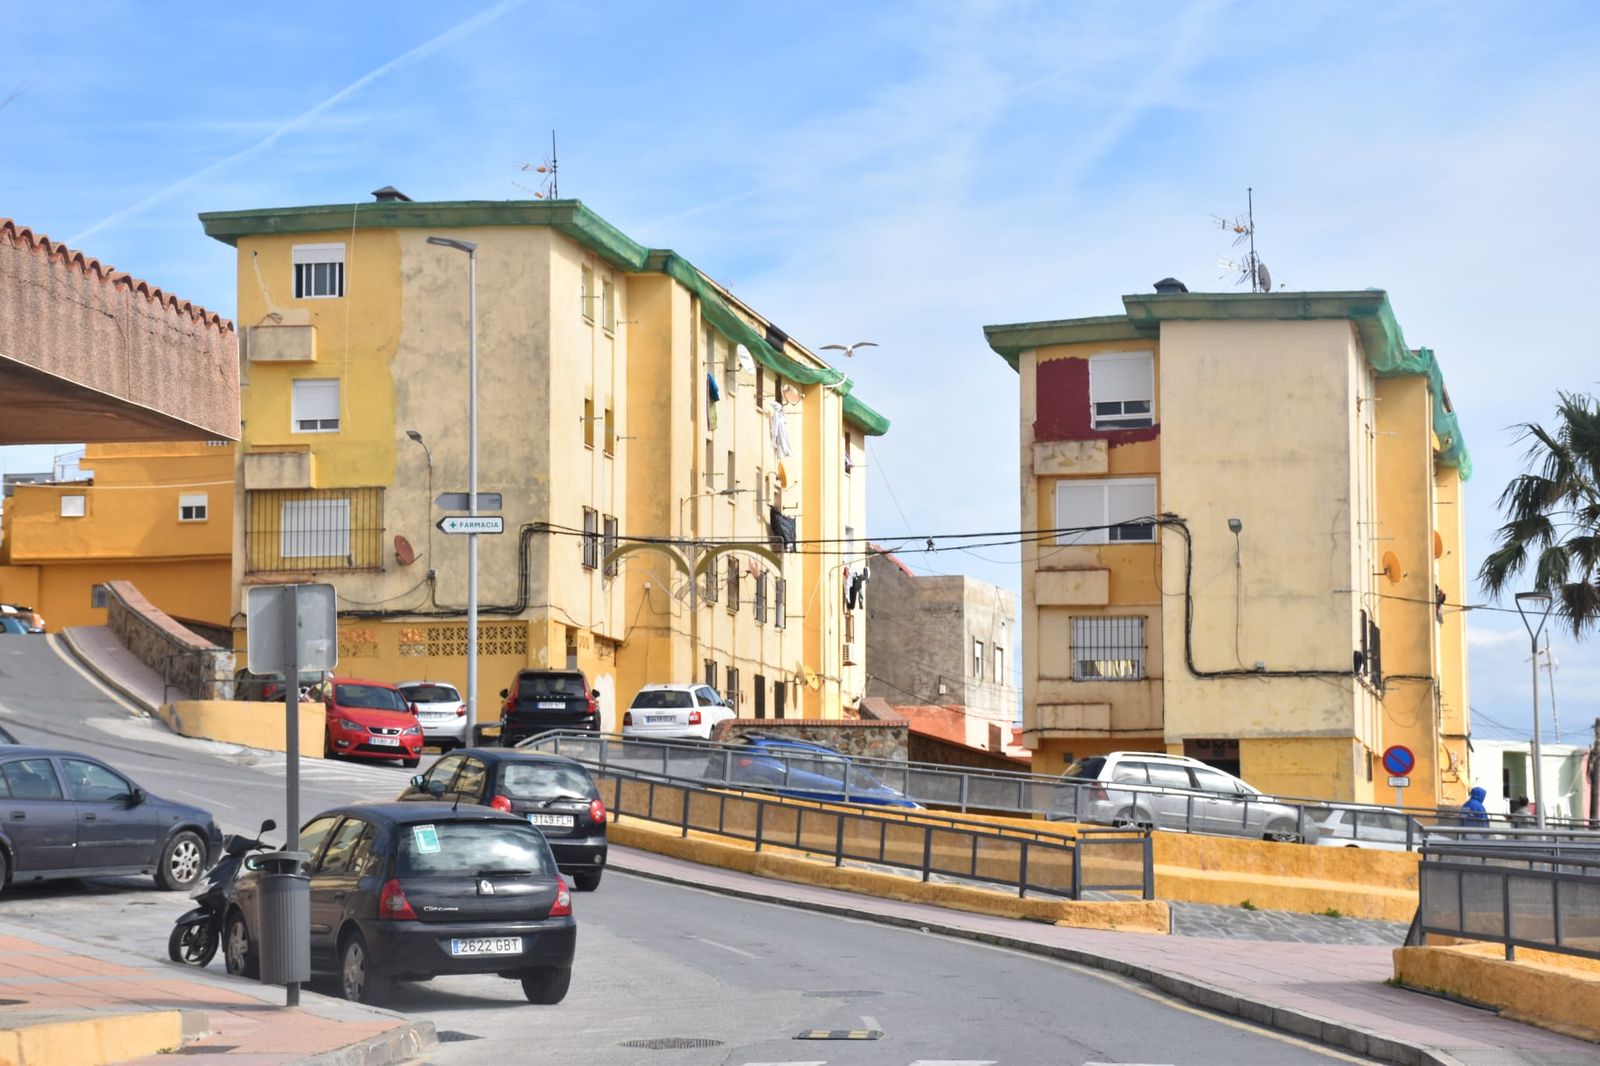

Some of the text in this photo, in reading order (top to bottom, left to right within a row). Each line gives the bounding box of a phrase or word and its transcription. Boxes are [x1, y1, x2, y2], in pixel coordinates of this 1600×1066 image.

[533, 813, 573, 827] 3149 FLH
[461, 940, 492, 953] 2622
[496, 938, 518, 951] GBT
